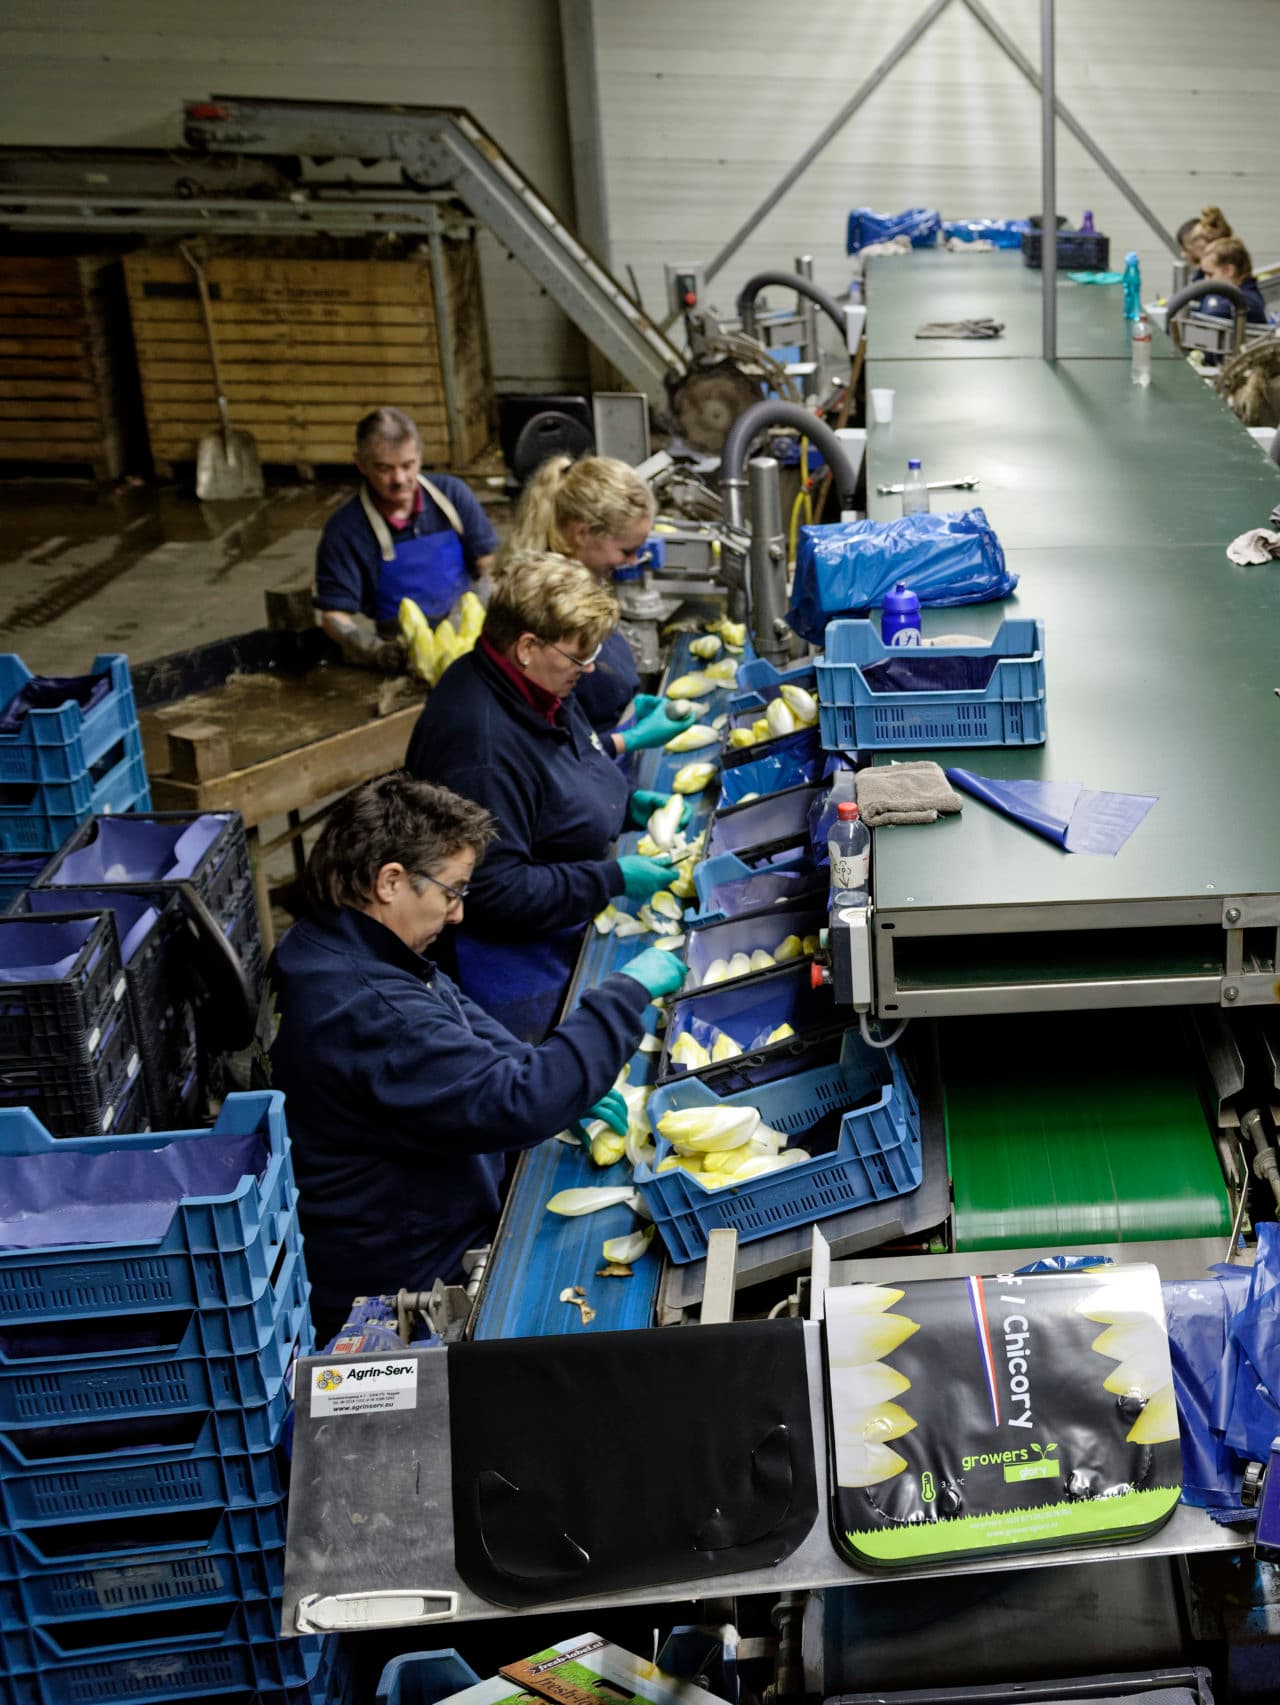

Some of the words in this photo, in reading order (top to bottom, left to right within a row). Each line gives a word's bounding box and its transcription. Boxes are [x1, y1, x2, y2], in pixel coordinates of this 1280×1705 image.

[346, 1365, 414, 1381] Agrin-Serv.
[1003, 1314, 1033, 1429] Chicory
[332, 1402, 394, 1412] www.agrinserv.eu
[961, 1448, 1029, 1471] growers
[538, 1641, 604, 1672] fresh-label.nl
